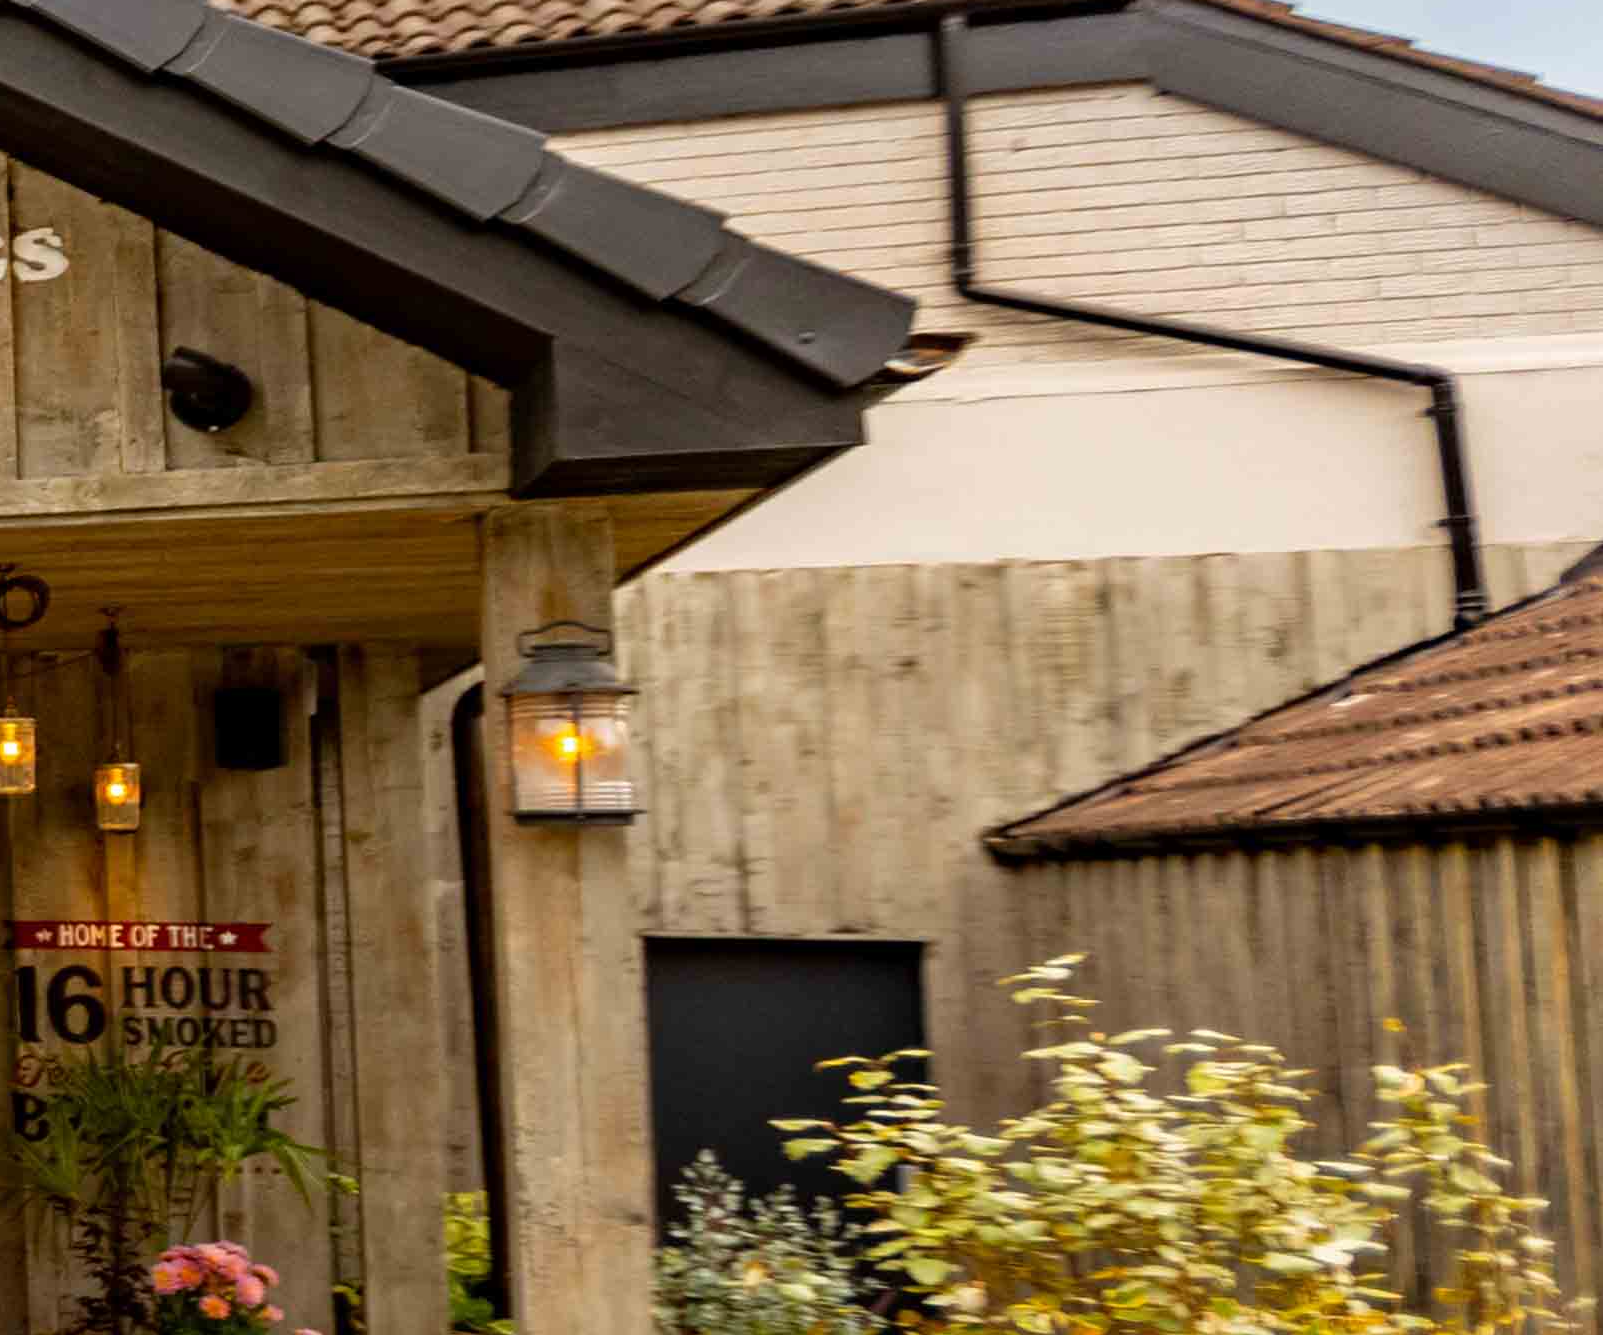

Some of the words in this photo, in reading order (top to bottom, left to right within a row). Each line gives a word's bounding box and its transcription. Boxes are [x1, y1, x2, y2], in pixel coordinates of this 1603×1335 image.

[57, 924, 125, 948] HOME
[130, 924, 161, 948] OF
[168, 925, 215, 950] THE
[13, 965, 106, 1044] 16
[121, 966, 276, 1012] HOUR
[122, 1016, 277, 1049] SMOKED
